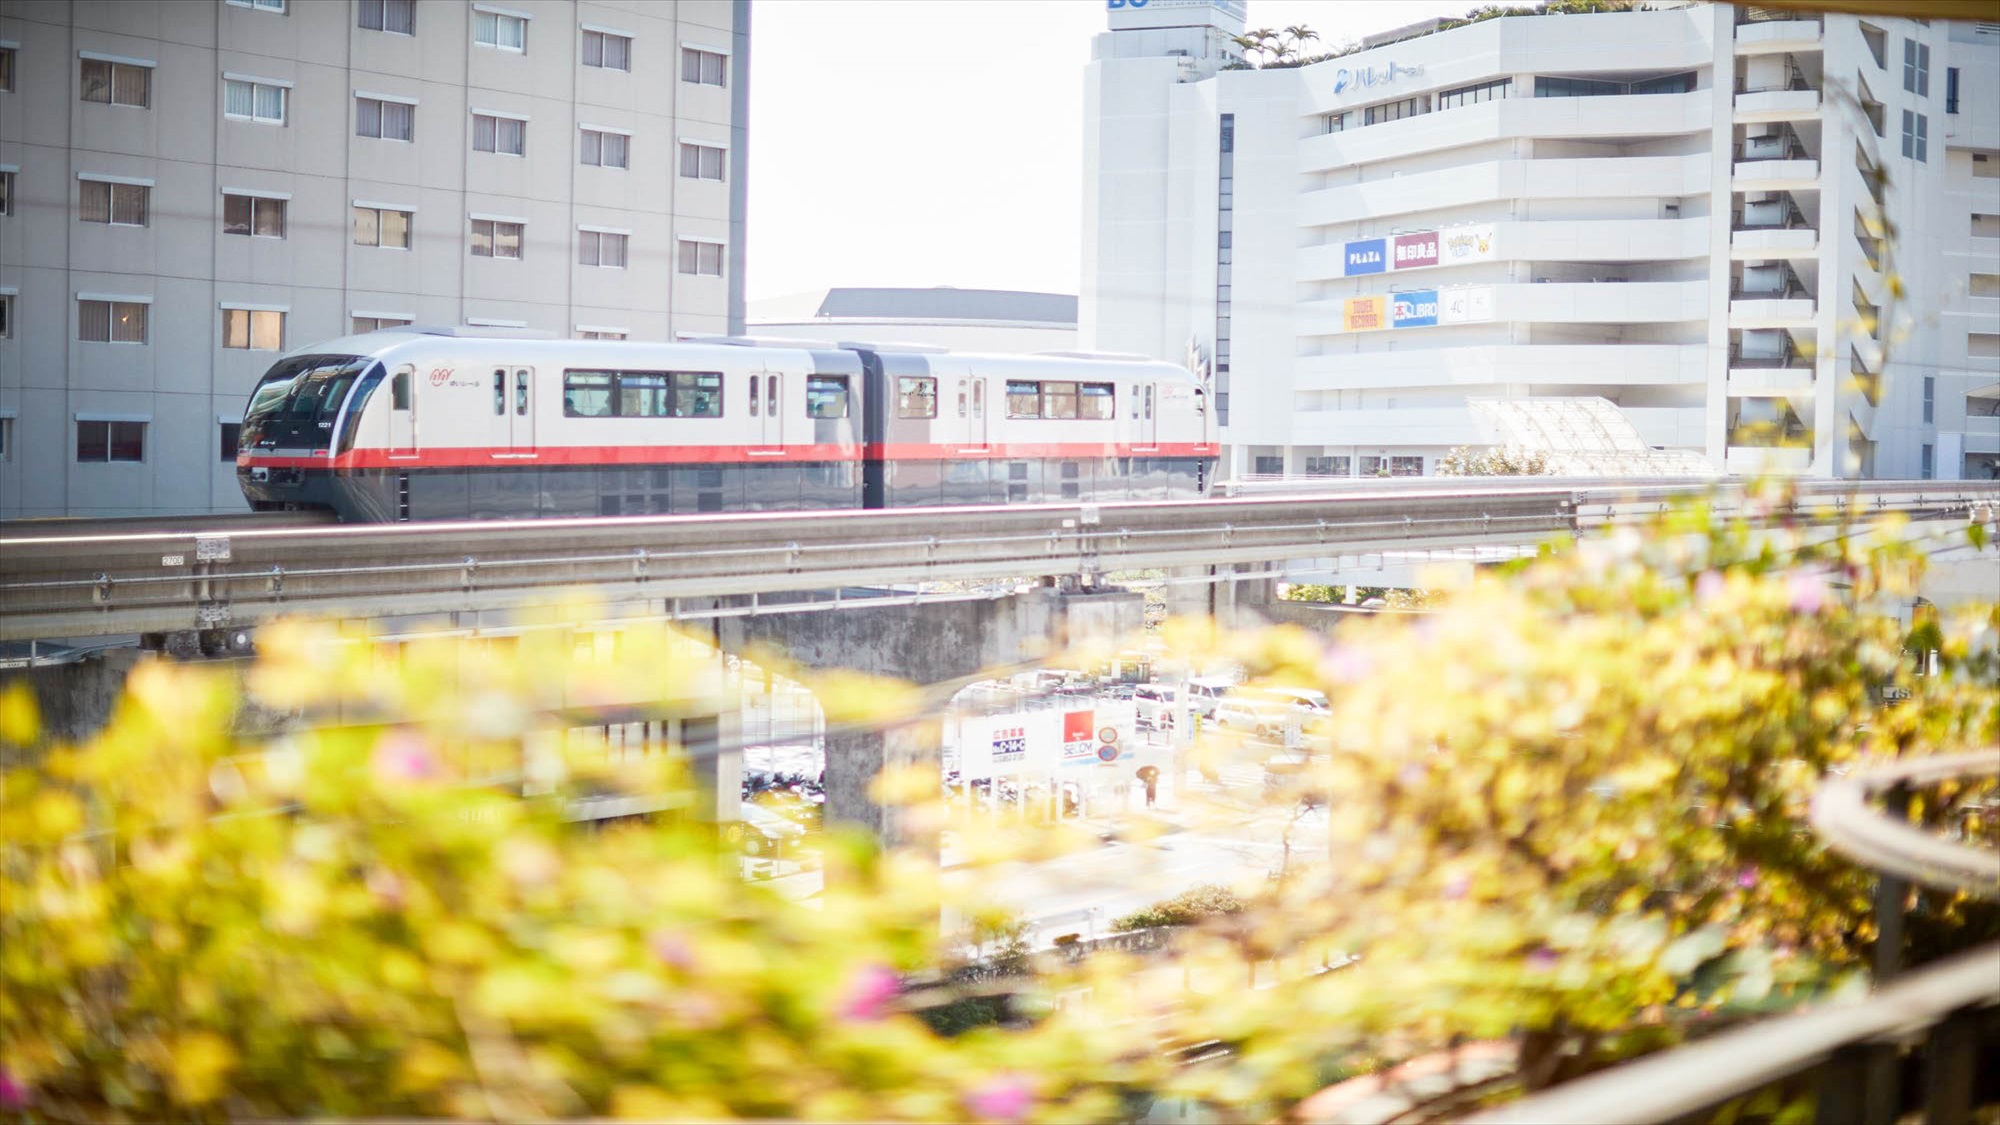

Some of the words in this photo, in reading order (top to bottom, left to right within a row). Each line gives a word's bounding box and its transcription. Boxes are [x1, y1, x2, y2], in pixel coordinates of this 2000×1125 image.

[1350, 251, 1381, 265] PLAZA
[1396, 241, 1437, 262] 無印良品
[1352, 299, 1373, 314] TOWER
[1410, 301, 1438, 318] LIBRO
[1351, 314, 1378, 329] RECORDS
